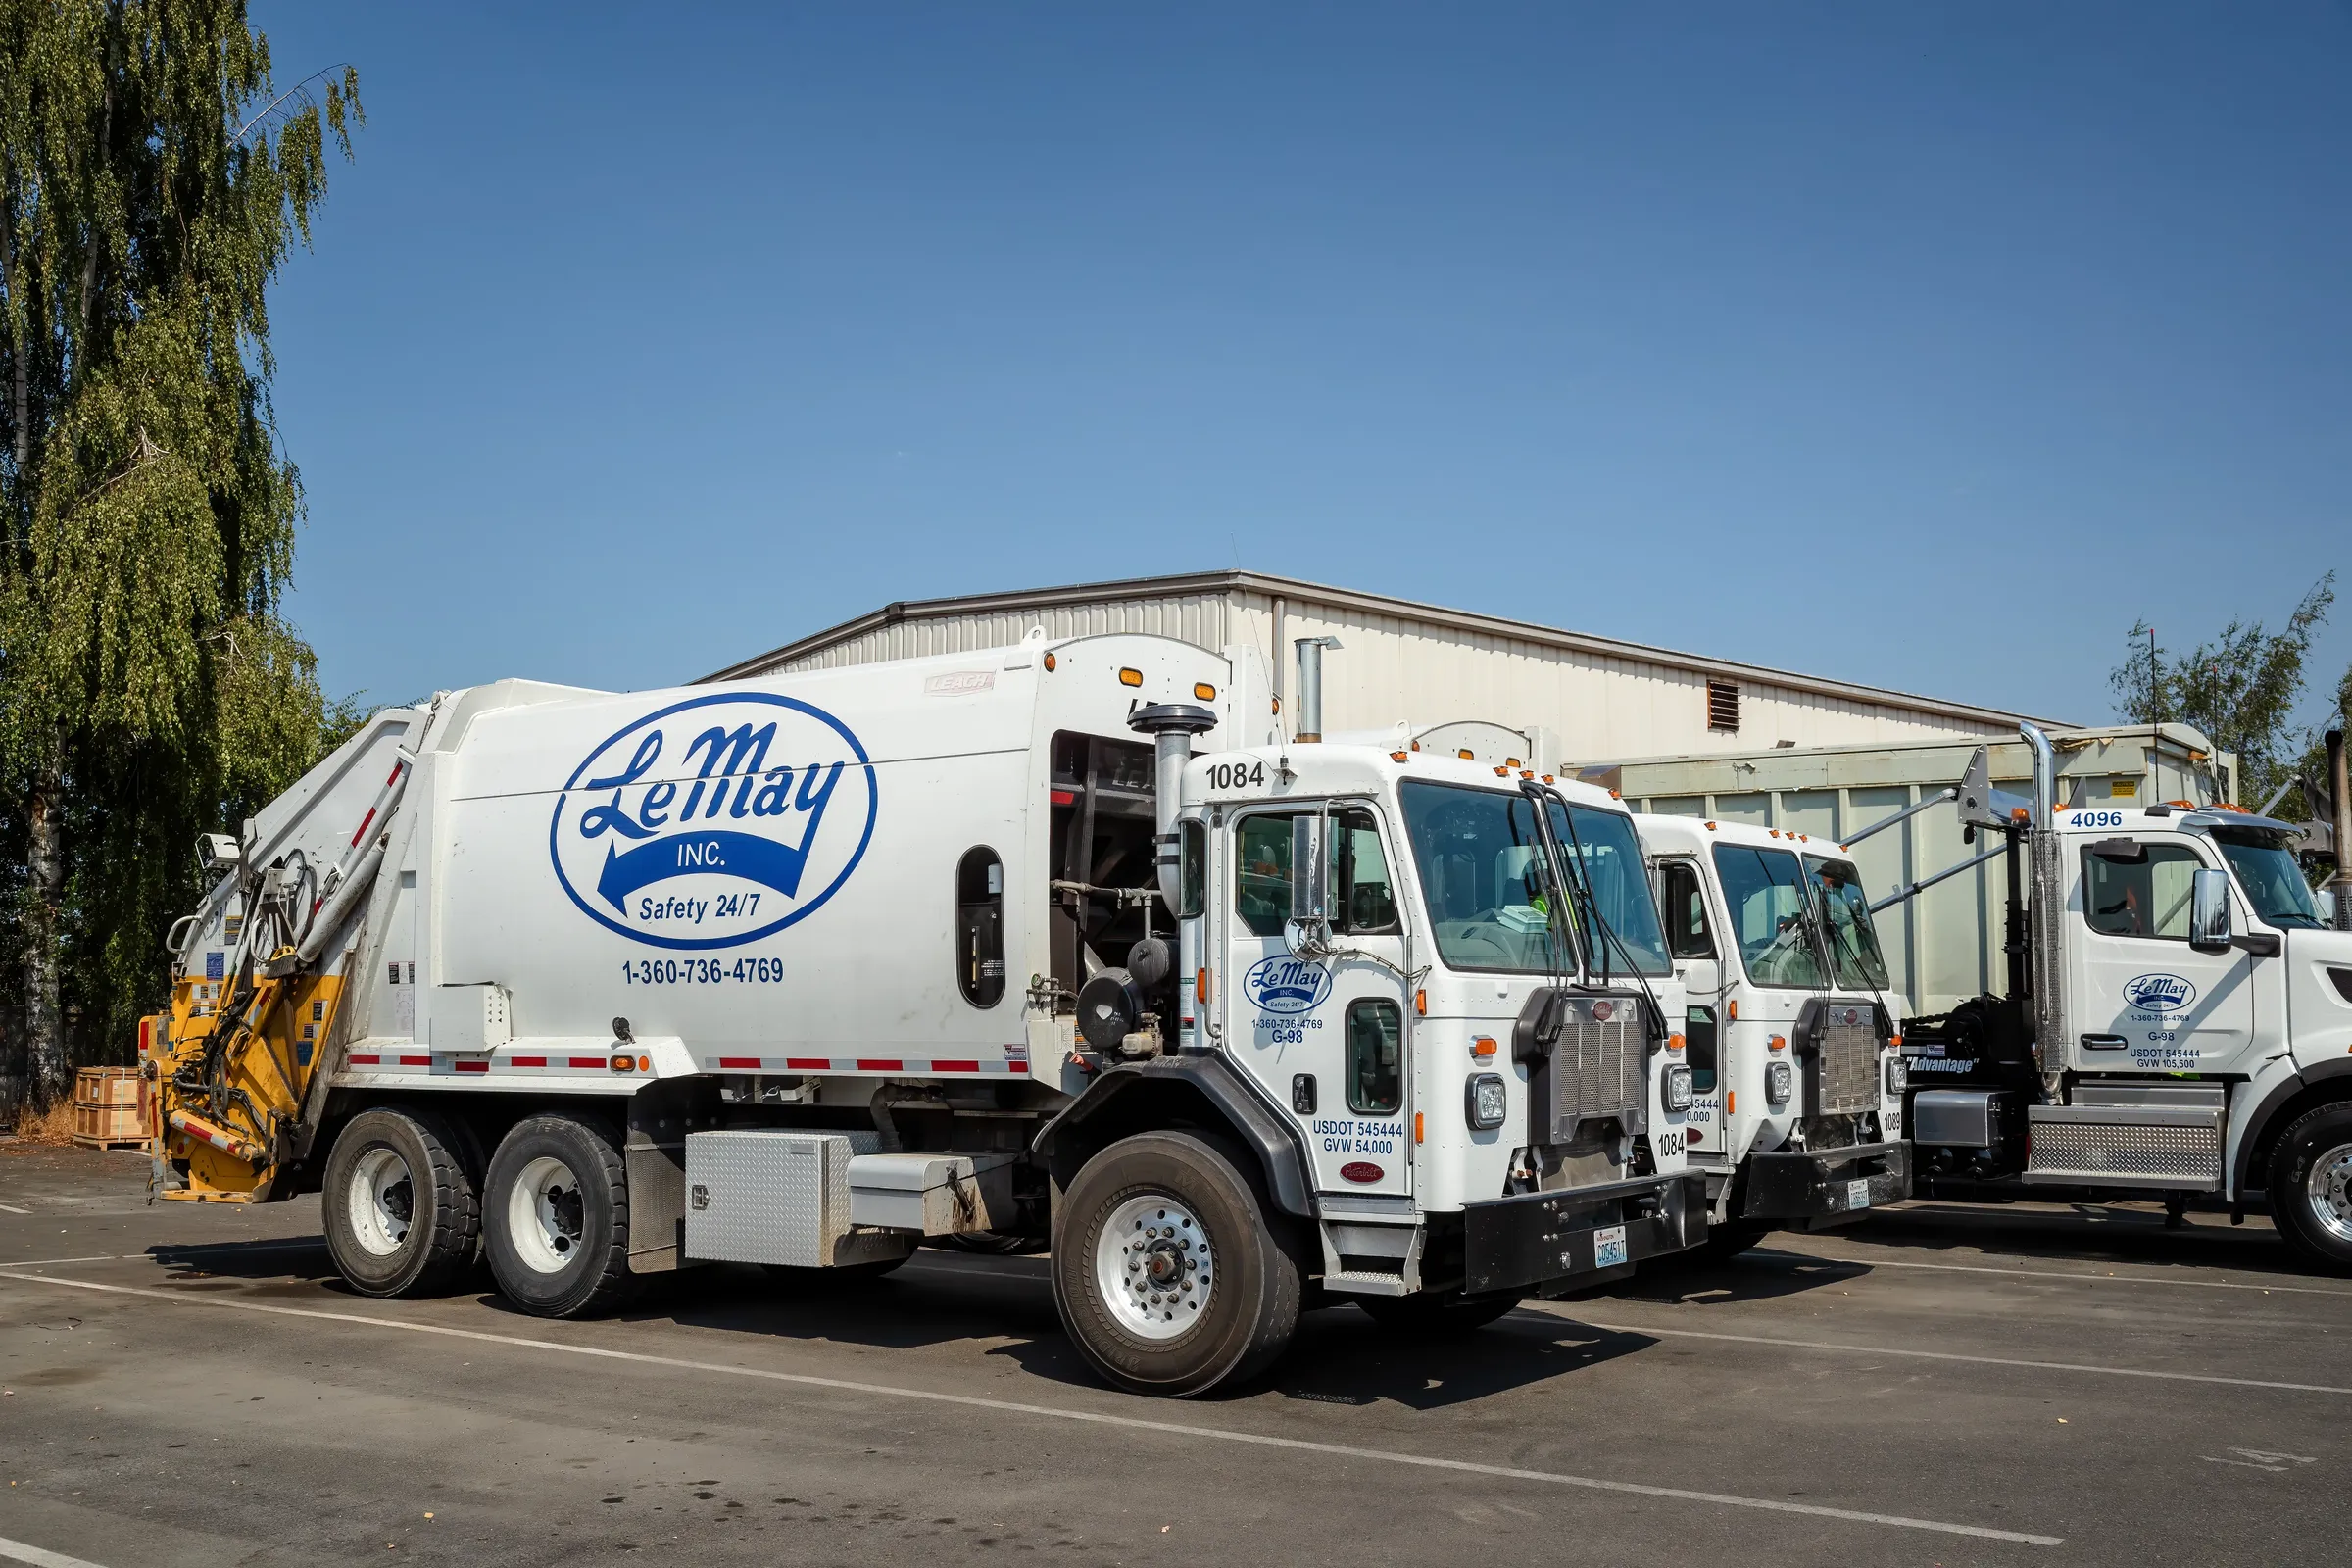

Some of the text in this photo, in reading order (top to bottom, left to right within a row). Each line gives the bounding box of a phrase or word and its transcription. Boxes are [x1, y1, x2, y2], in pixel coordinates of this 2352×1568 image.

[930, 673, 989, 692] LEACH
[579, 720, 845, 849] LeMay
[1205, 761, 1265, 790] 1084
[2070, 811, 2123, 827] 4096
[677, 841, 726, 867] INC.
[639, 893, 761, 924] Safety 24/7
[622, 957, 783, 984] 1-360-736-4769
[1251, 961, 1323, 993] LeMay
[2130, 978, 2188, 998] LeMay
[1251, 1019, 1323, 1029] 1-360-736-4769
[1272, 1029, 1303, 1043] G-98
[2148, 1031, 2175, 1041] G-98
[2130, 1049, 2200, 1058] USDOT 545444
[1906, 1056, 1980, 1074] "Advantage"
[2137, 1058, 2195, 1069] GVW 105,500
[1313, 1119, 1403, 1137] USDOT 545444
[1884, 1111, 1901, 1131] 1089
[1323, 1138, 1393, 1155] GVW 54,000
[1658, 1132, 1685, 1157] 1084
